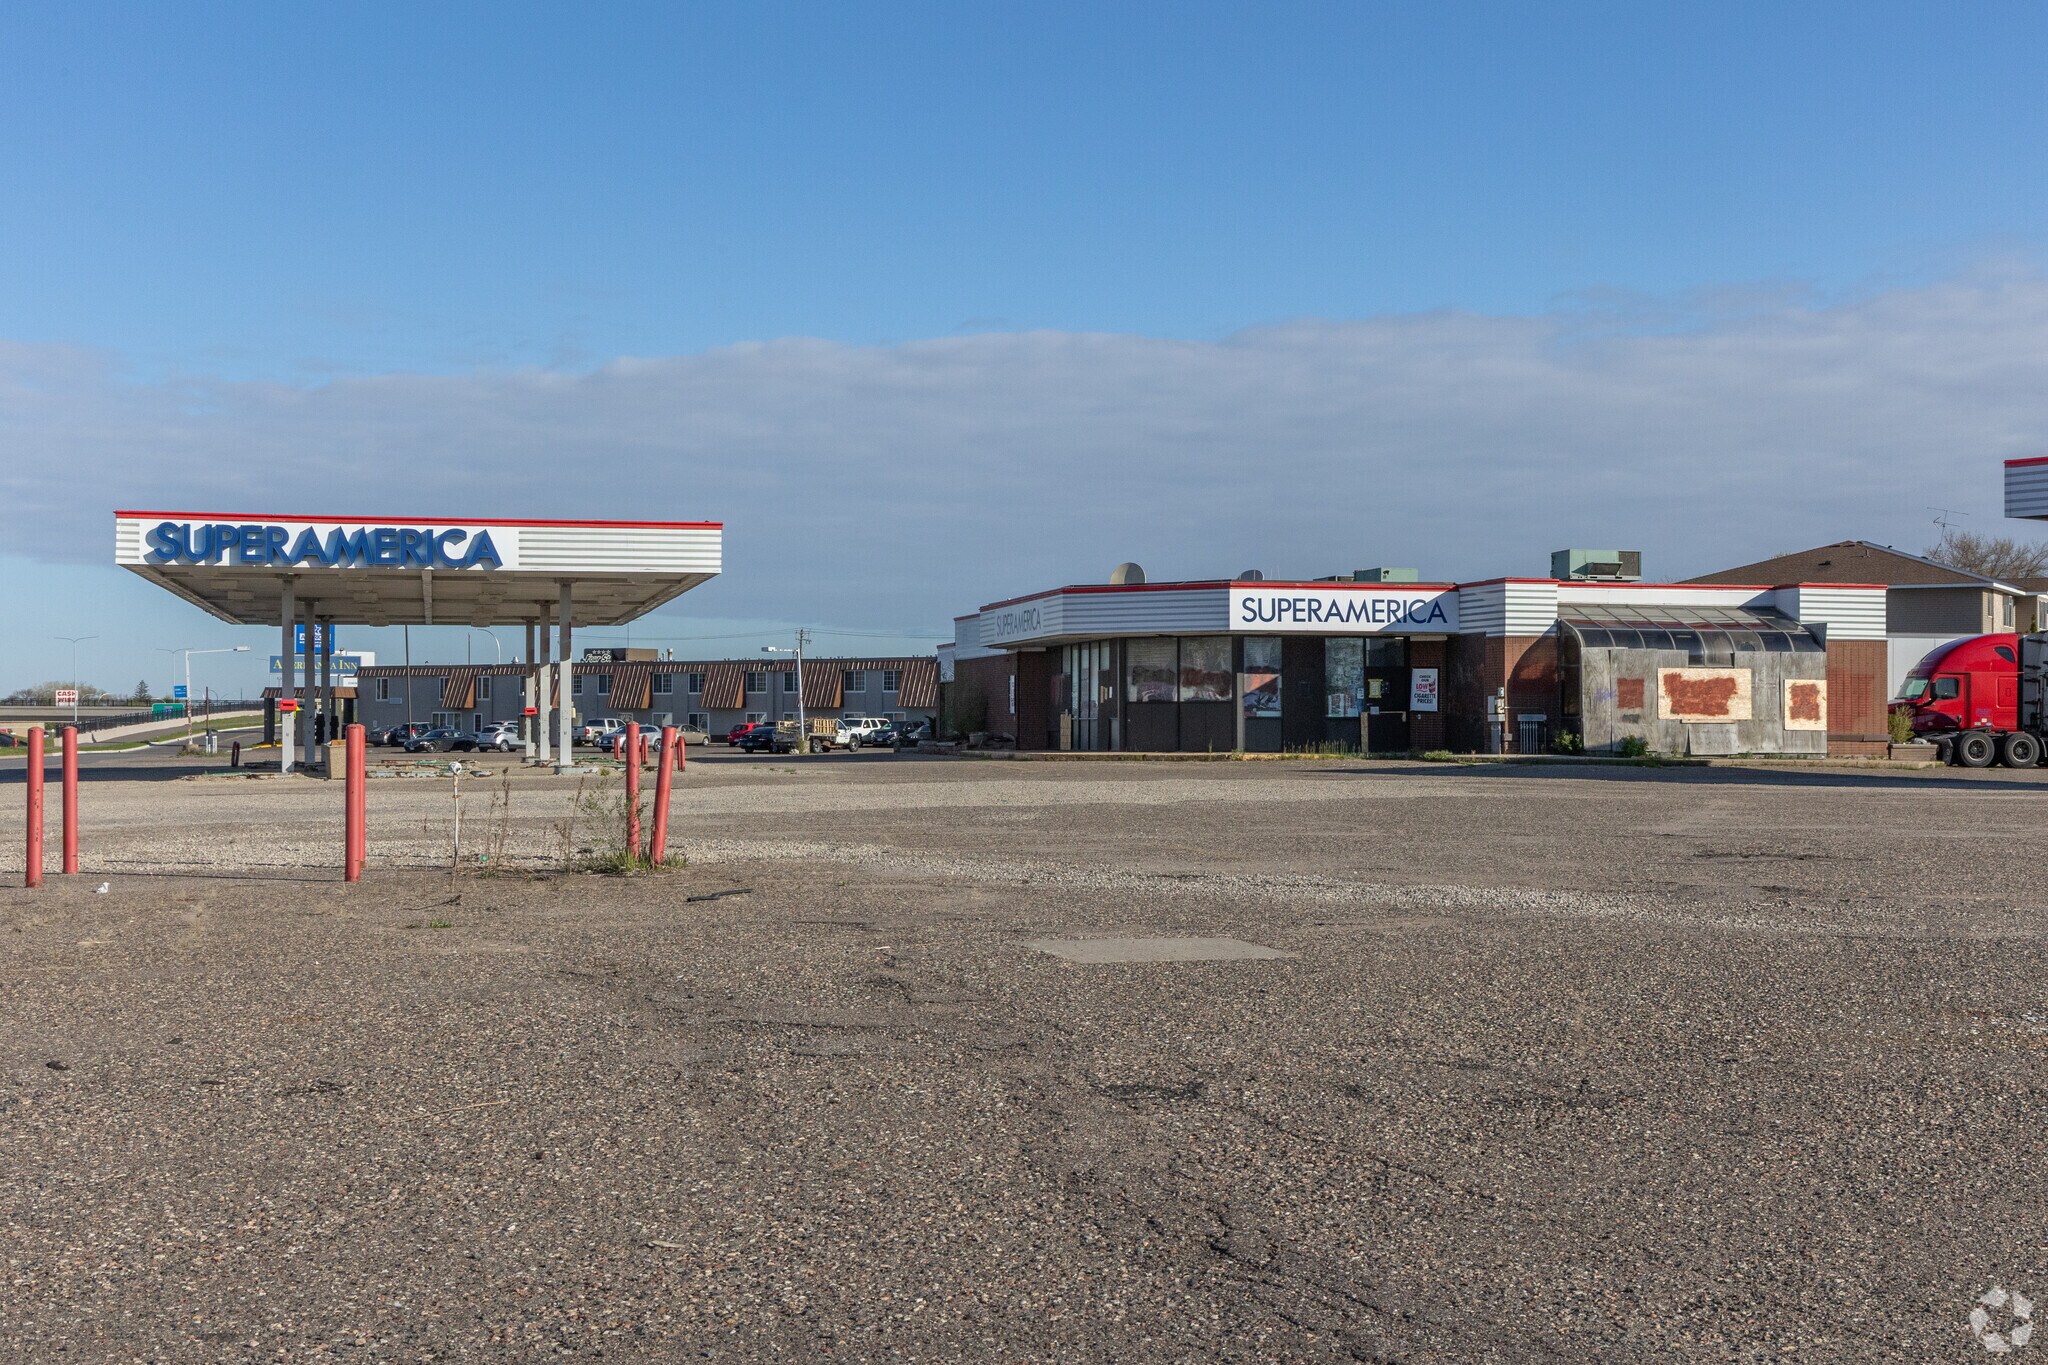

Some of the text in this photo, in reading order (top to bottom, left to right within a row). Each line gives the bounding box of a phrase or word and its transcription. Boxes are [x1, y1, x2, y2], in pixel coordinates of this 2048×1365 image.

[152, 521, 504, 568] SUPERAMERICA
[996, 607, 1042, 637] SUPERAMERICA
[1241, 596, 1448, 625] SUPERAMERICA
